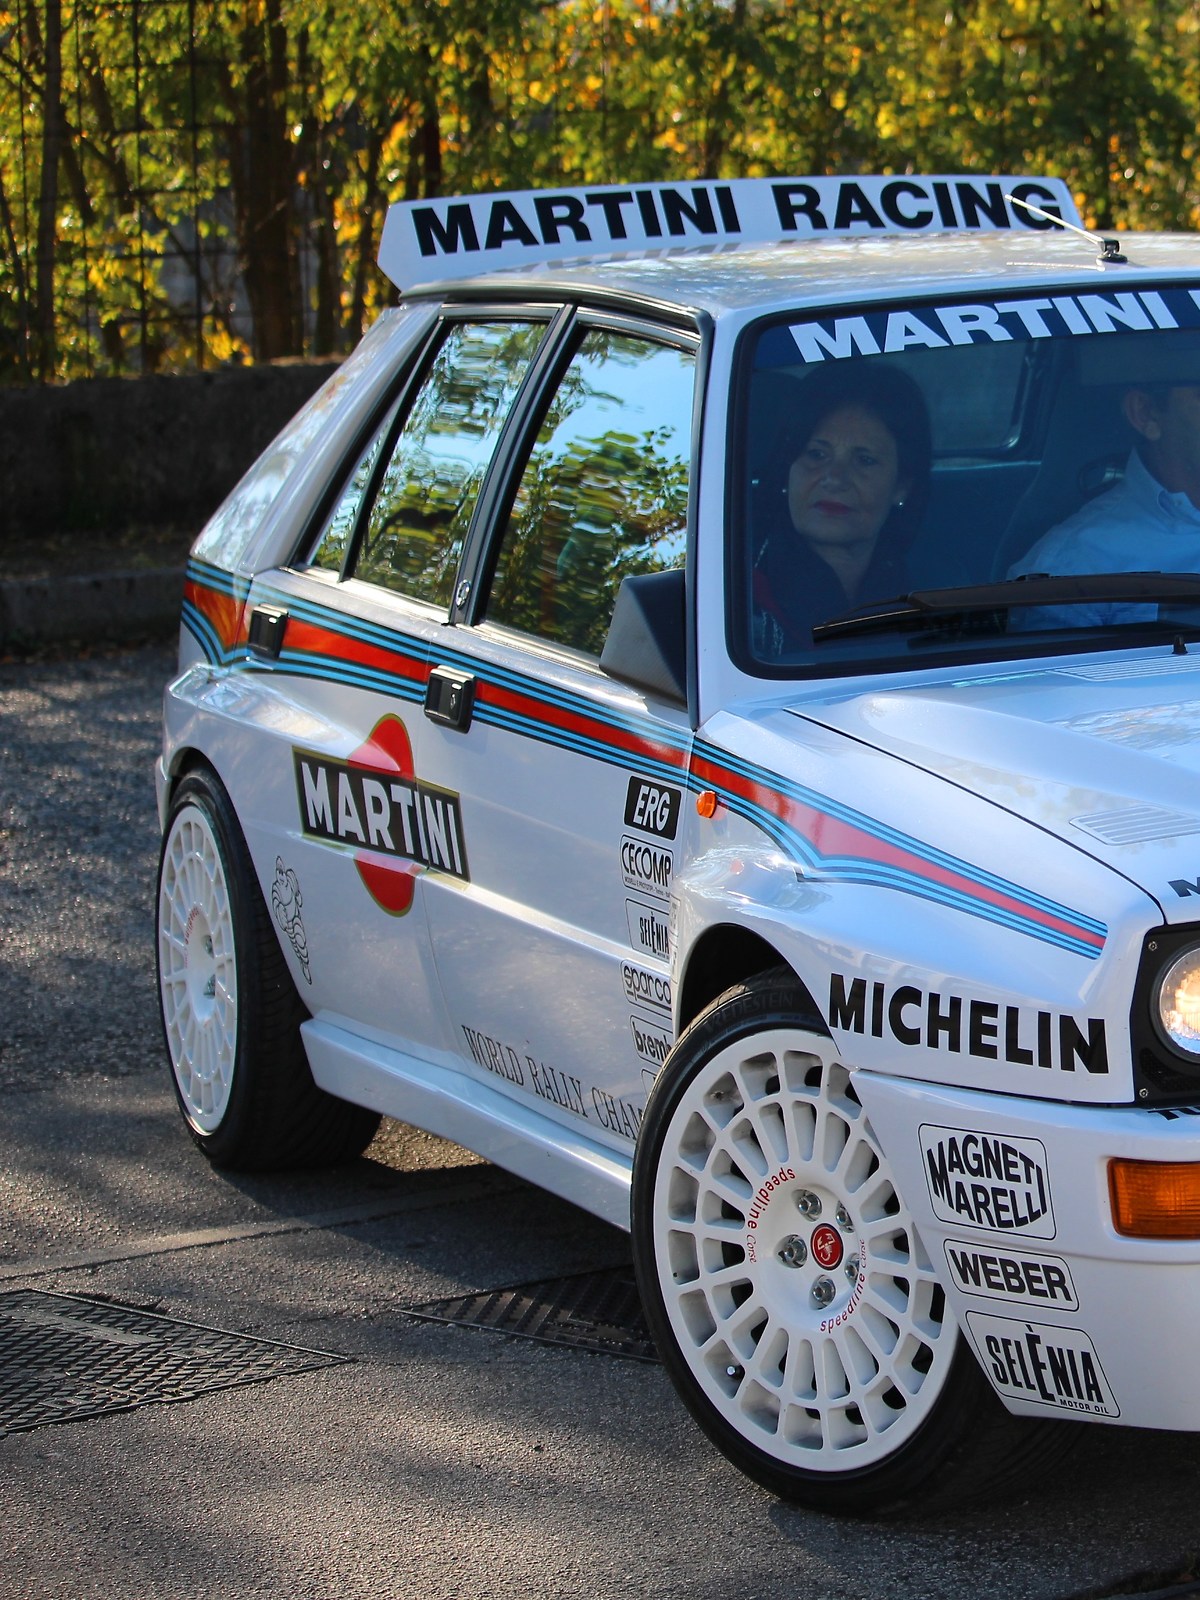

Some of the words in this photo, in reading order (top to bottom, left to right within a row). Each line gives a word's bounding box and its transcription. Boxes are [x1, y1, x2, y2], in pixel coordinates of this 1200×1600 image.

[411, 186, 741, 257] MARTINI
[771, 181, 1064, 232] RACING
[788, 291, 1179, 363] MARTINI
[300, 761, 463, 875] MARTINI
[633, 784, 671, 831] ERG
[622, 842, 671, 887] CECOMP
[624, 965, 671, 1004] sparco
[829, 972, 1109, 1074] MICHELIN
[461, 1025, 524, 1086] WORLD
[525, 1056, 588, 1118] RALLY
[747, 1167, 796, 1229] speedline
[926, 1134, 1047, 1202] MAGNETI
[820, 1274, 866, 1334] speedline
[949, 1249, 1073, 1301] WEBER
[1060, 1398, 1091, 1411] MOTOR
[1094, 1405, 1109, 1415] OIL
